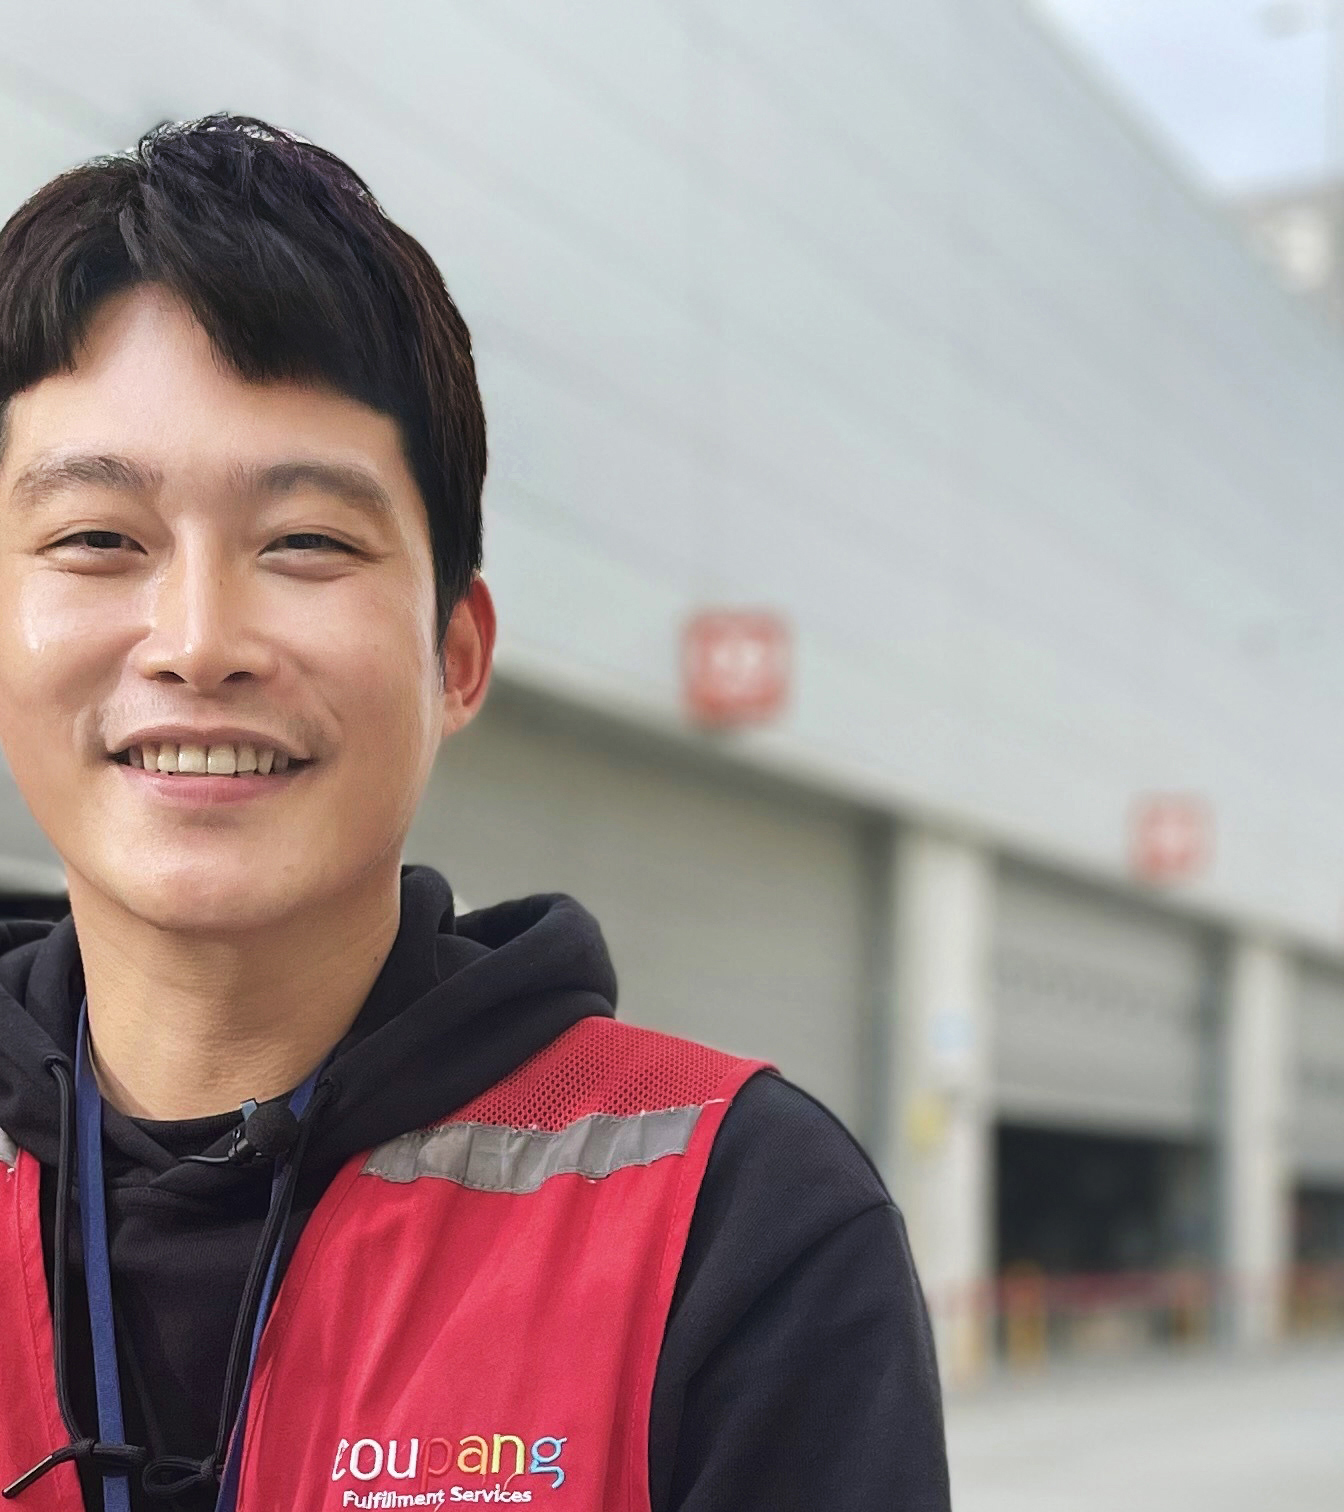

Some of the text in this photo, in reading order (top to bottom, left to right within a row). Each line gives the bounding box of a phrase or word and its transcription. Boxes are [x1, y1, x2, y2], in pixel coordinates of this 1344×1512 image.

[331, 1433, 568, 1490] coupang
[342, 1483, 532, 1511] Fulfillment Services
